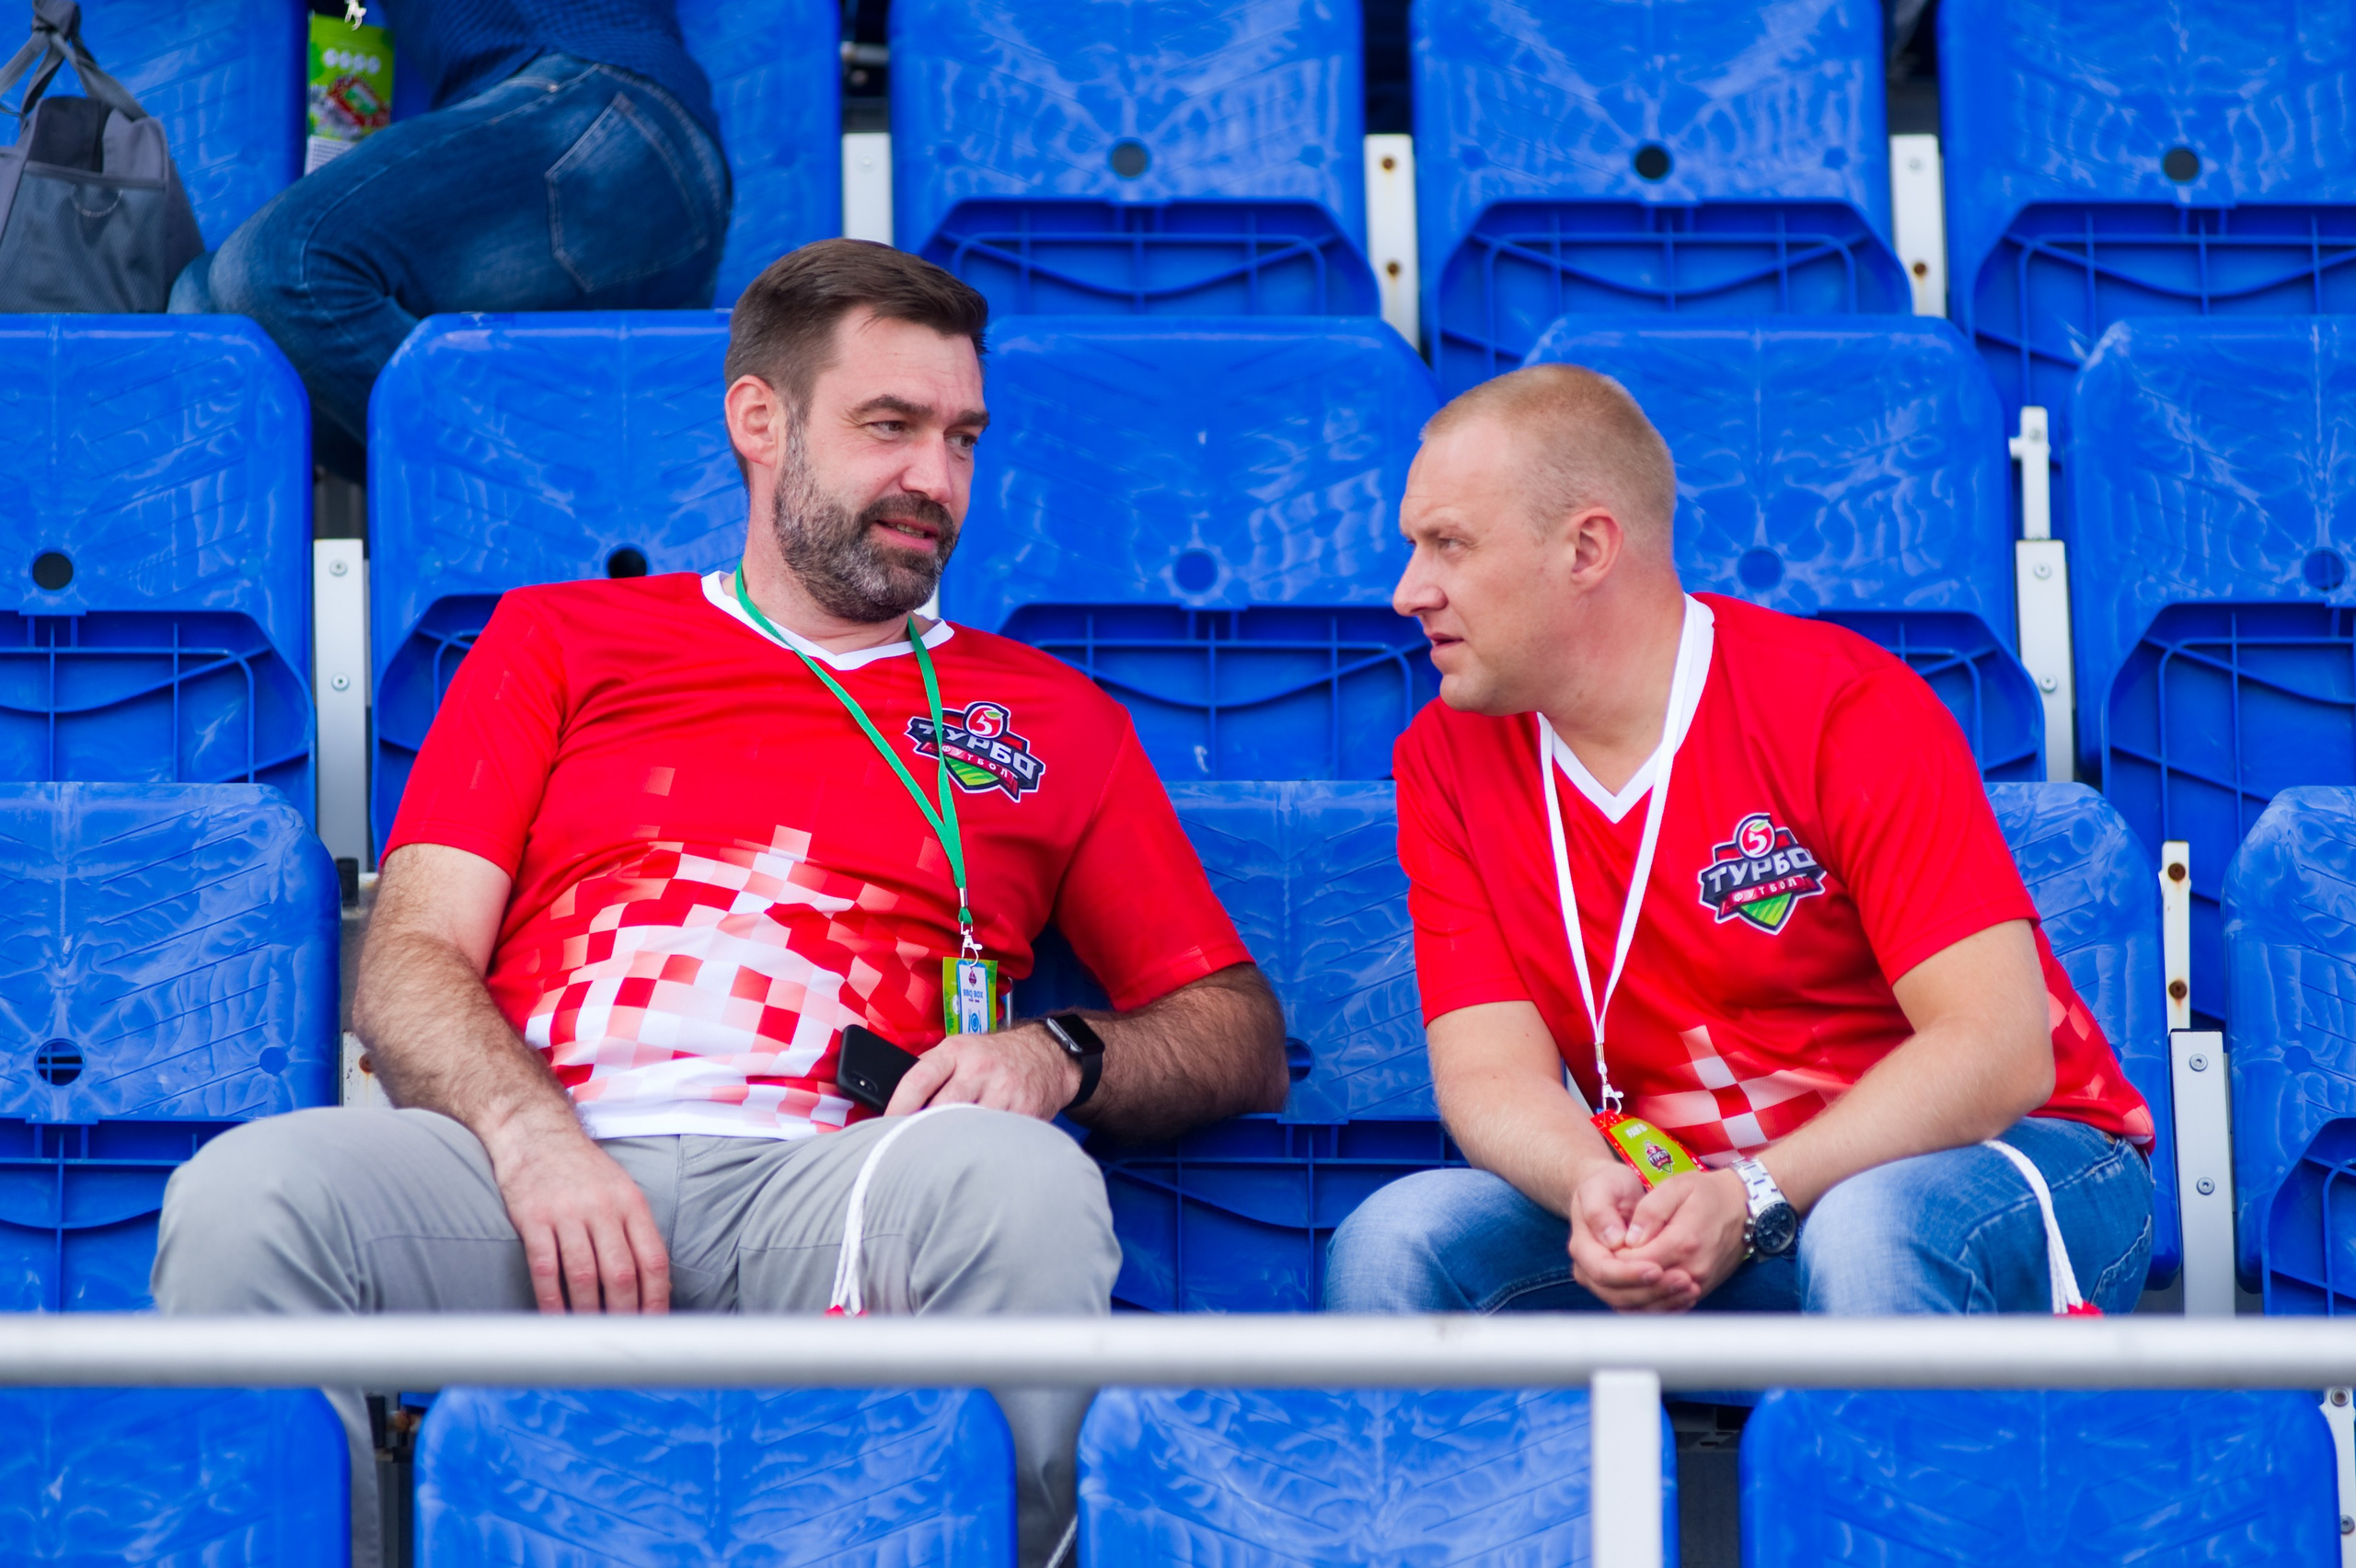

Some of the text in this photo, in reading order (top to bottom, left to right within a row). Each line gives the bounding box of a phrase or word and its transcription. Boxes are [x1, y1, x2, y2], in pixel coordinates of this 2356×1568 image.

[918, 723, 1036, 779] ТУРБО
[941, 744, 1008, 778] ФУТБОЛ
[1708, 847, 1818, 893] ТУРБО
[1734, 877, 1796, 902] ФУТБОЛ
